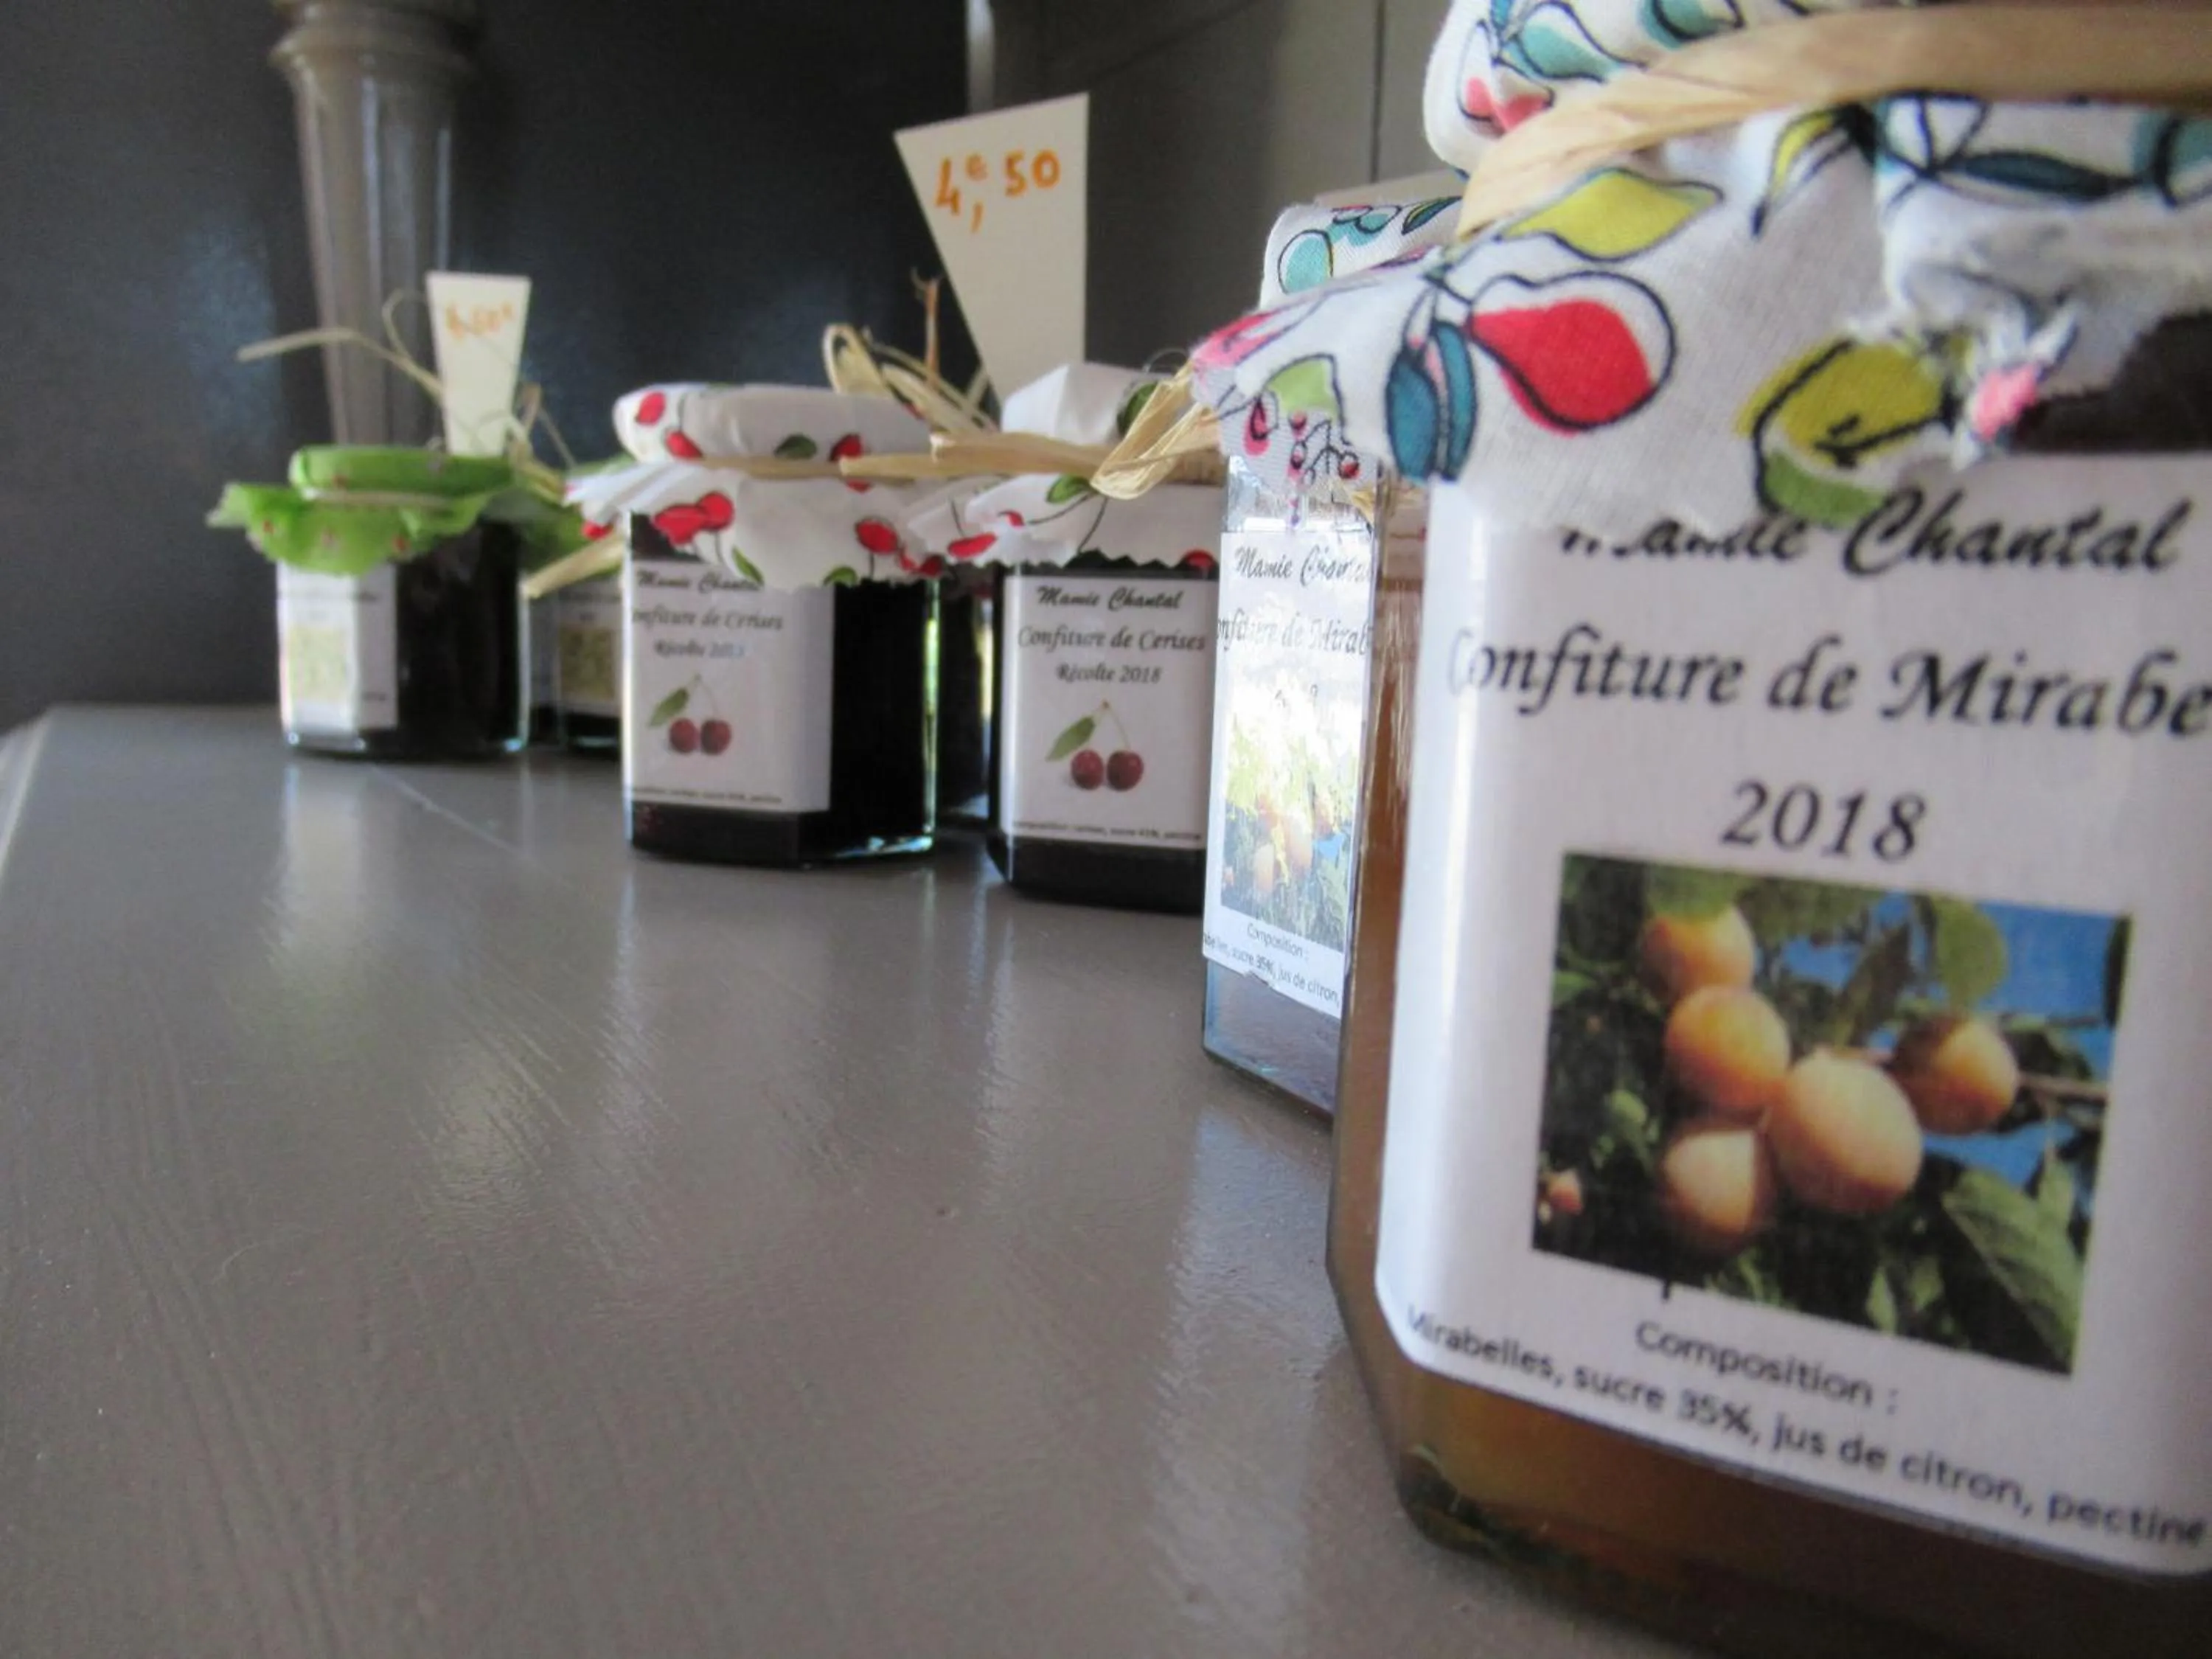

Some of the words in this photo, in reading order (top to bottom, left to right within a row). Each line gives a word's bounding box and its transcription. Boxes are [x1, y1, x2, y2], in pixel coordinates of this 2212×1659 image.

[1235, 546, 1294, 579] Mamie
[1562, 518, 1806, 560] amie
[1842, 484, 2193, 577] Chantal
[1018, 625, 1105, 653] Confiture
[1110, 625, 1133, 649] de
[1139, 628, 1206, 651] Cerises
[1037, 585, 1099, 607] Mamie
[1107, 585, 1183, 611] Chantal
[1119, 665, 1161, 684] 2018
[1768, 634, 1857, 712] de
[1881, 648, 2212, 737] Mirabe
[1719, 778, 1927, 862] 2018
[1635, 1320, 1873, 1407] Composition
[1574, 1365, 1666, 1411] sucre
[1677, 1388, 1760, 1444] 35%,
[1773, 1411, 1826, 1455] jus
[1838, 1432, 1888, 1472] de
[1900, 1450, 2034, 1518] citron,
